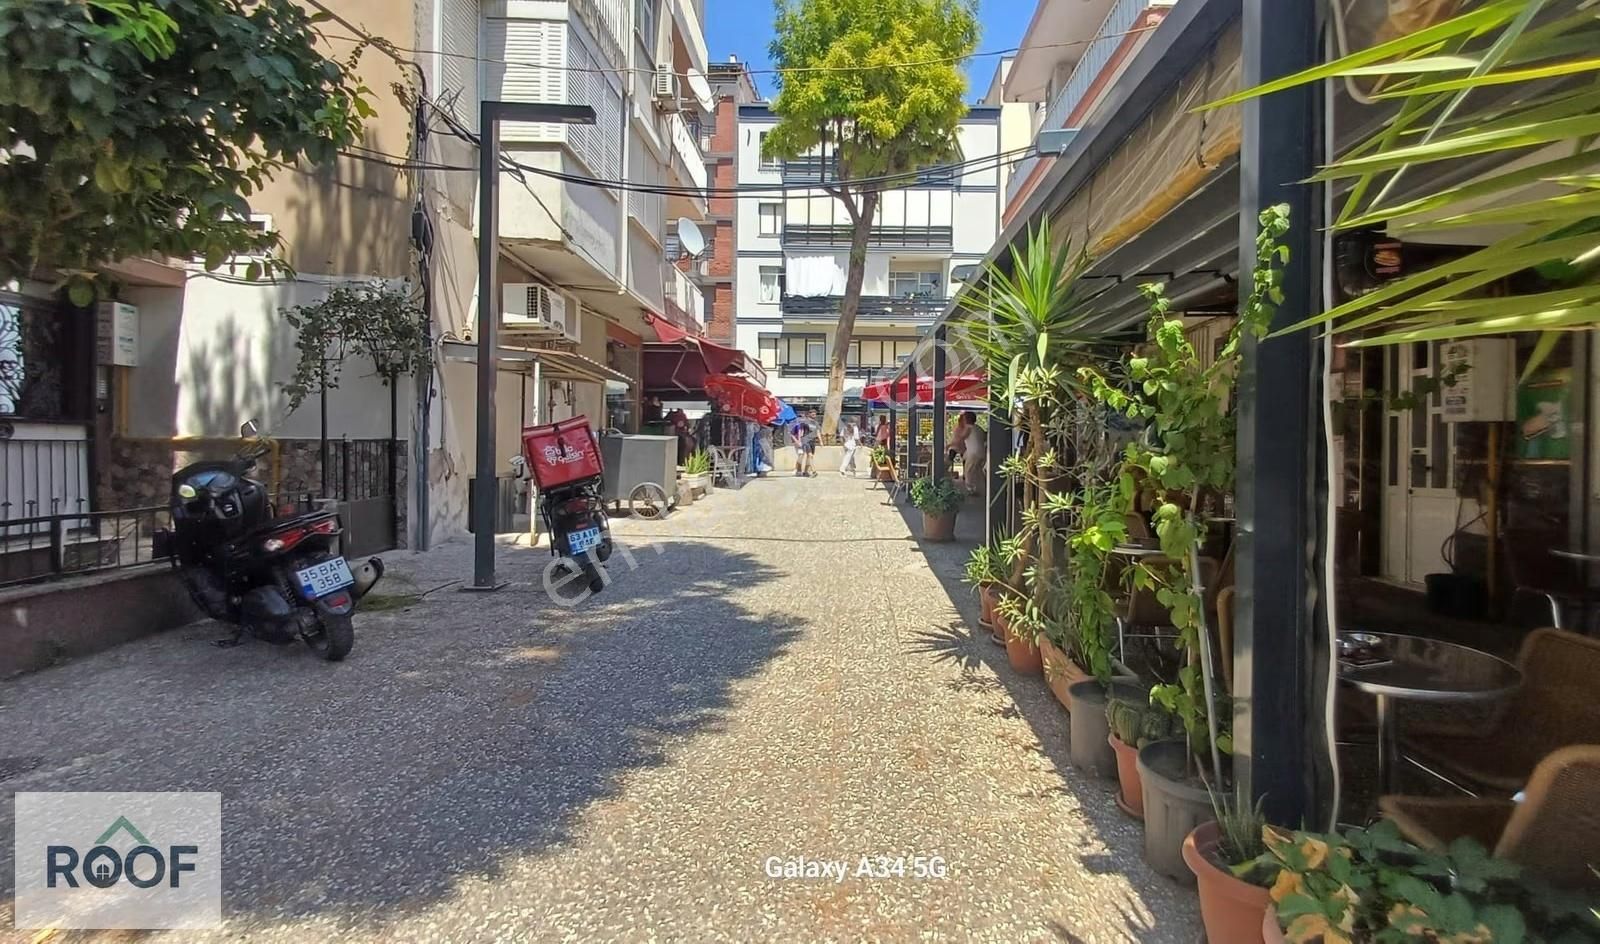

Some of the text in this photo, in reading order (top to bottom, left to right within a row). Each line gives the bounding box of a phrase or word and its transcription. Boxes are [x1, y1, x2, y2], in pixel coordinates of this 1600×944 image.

[300, 559, 344, 582] 35 BAP
[318, 573, 341, 589] 358
